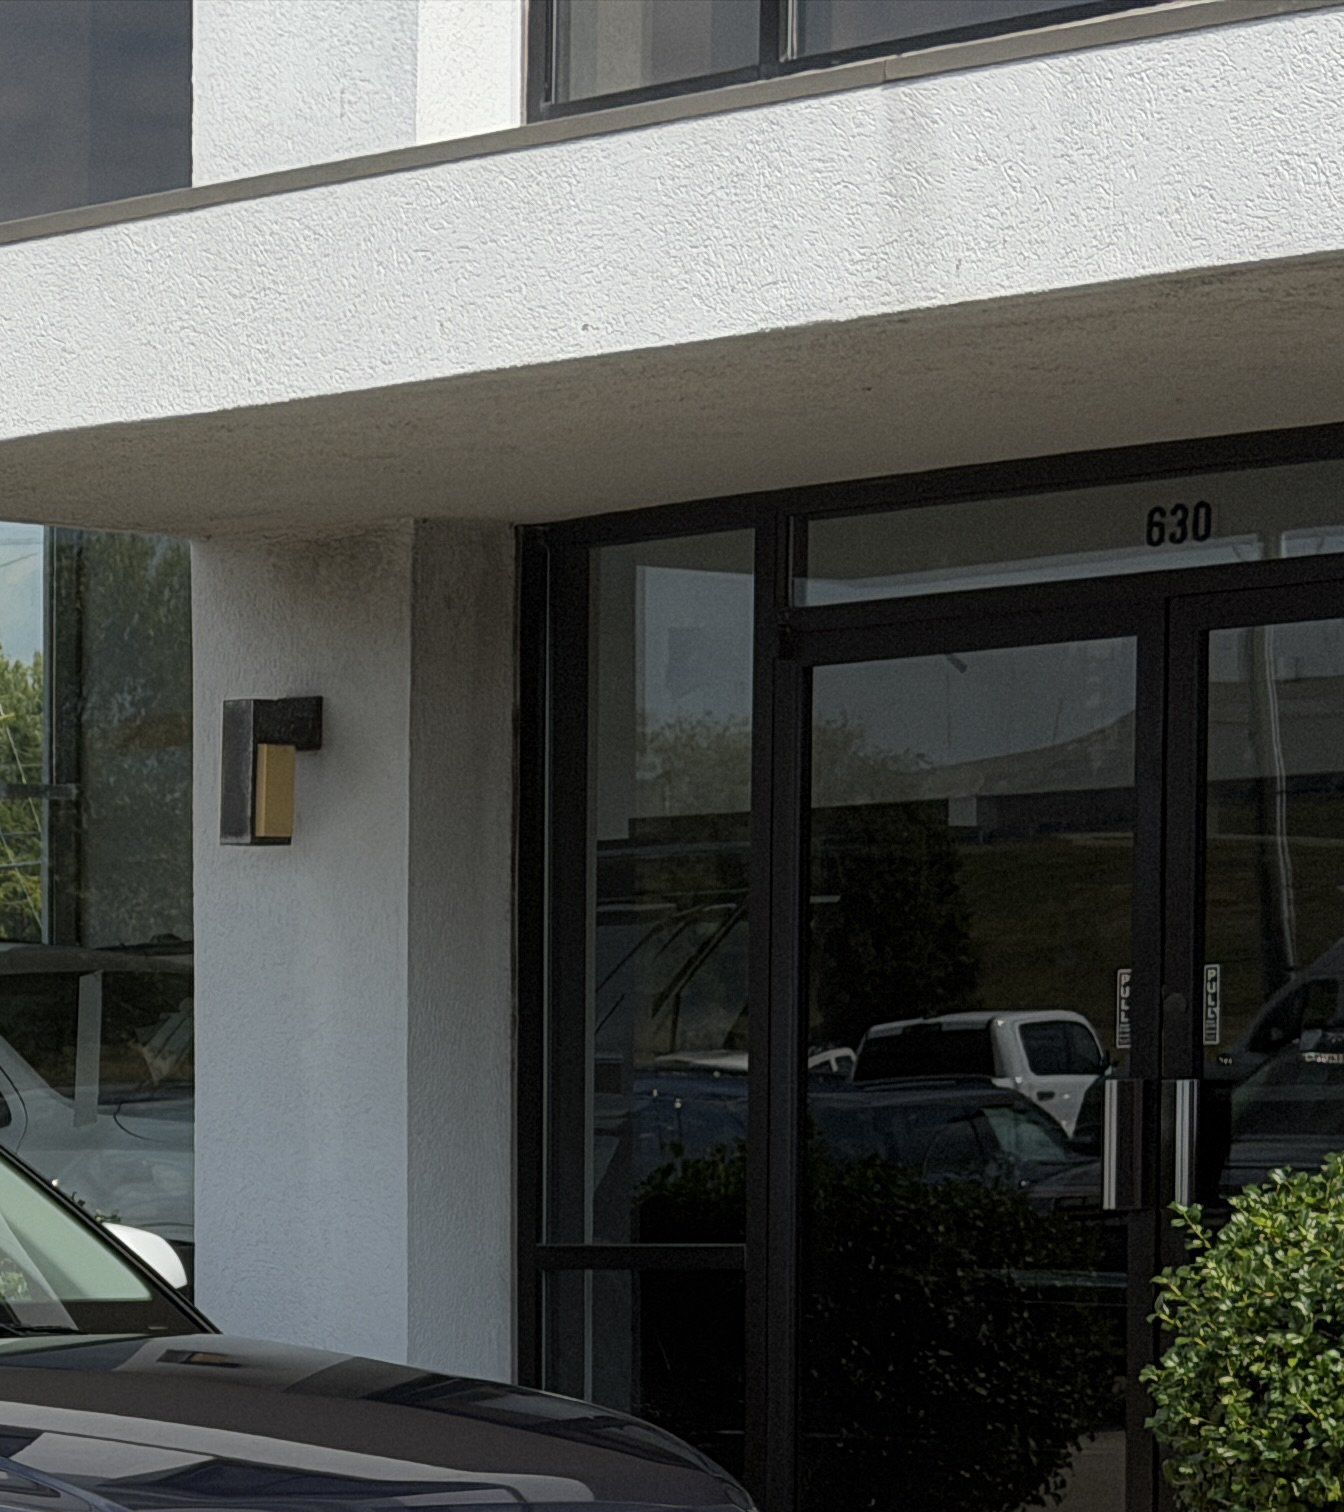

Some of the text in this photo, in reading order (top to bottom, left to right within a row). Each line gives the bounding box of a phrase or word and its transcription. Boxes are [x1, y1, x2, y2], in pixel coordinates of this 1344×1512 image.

[1146, 500, 1212, 546] 630
[1120, 974, 1131, 1022] PULL
[1206, 969, 1217, 1018] PULL
